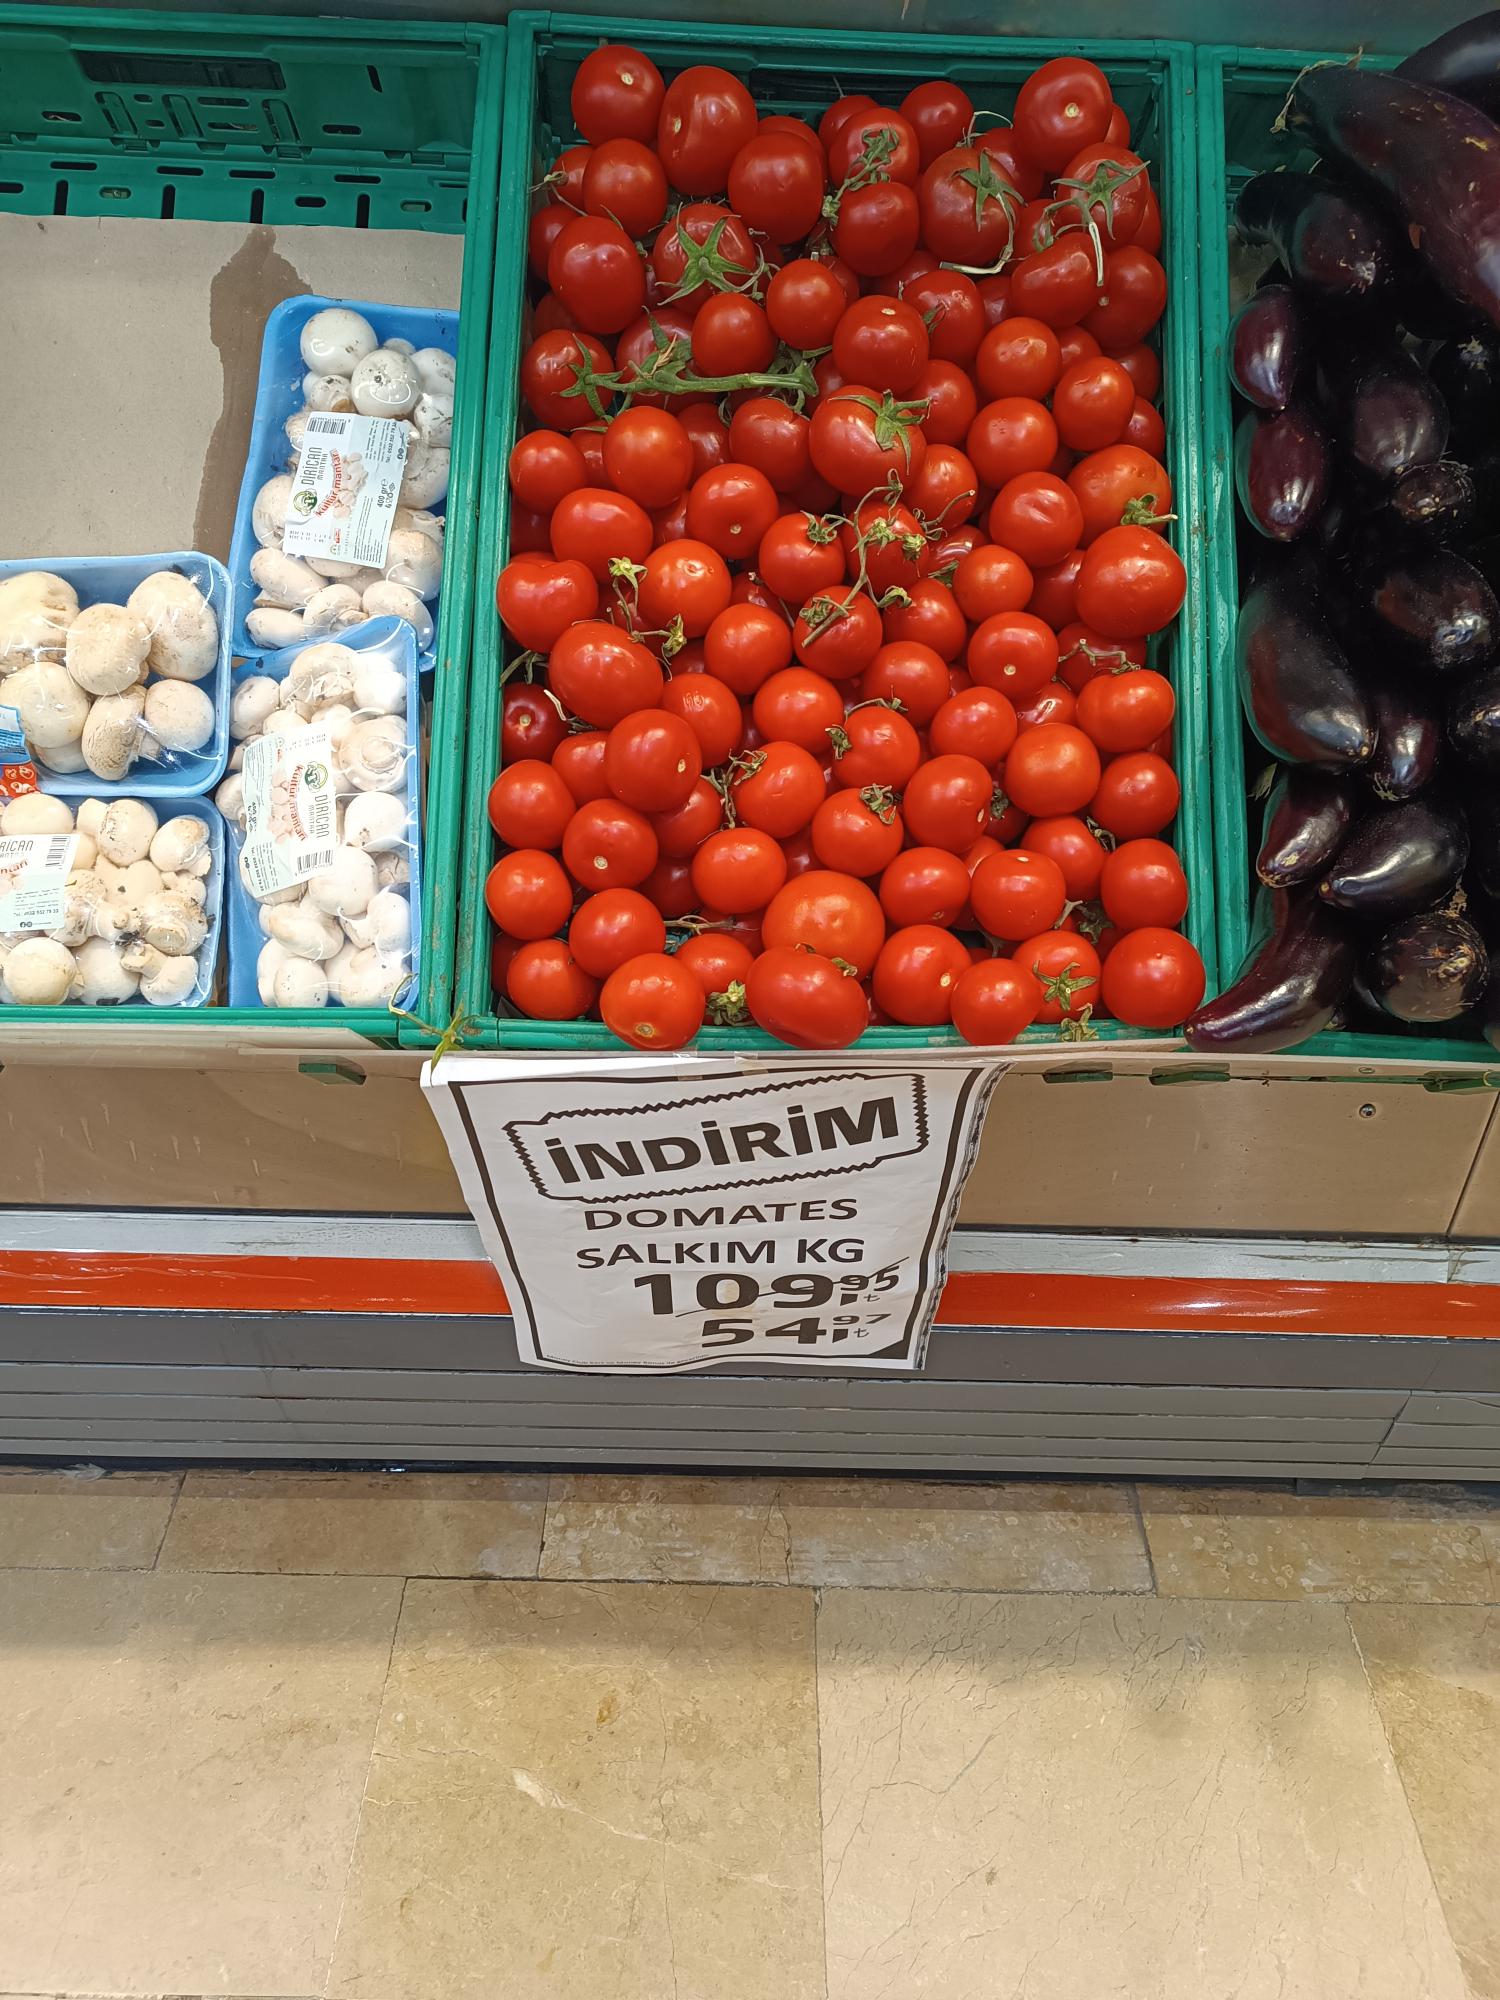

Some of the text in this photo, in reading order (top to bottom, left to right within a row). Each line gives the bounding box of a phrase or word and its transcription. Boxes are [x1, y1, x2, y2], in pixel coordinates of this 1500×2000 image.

[544, 1096, 899, 1184] İNDİRİM
[585, 1199, 858, 1231] DOMATES
[576, 1238, 865, 1270] SALKIM KG
